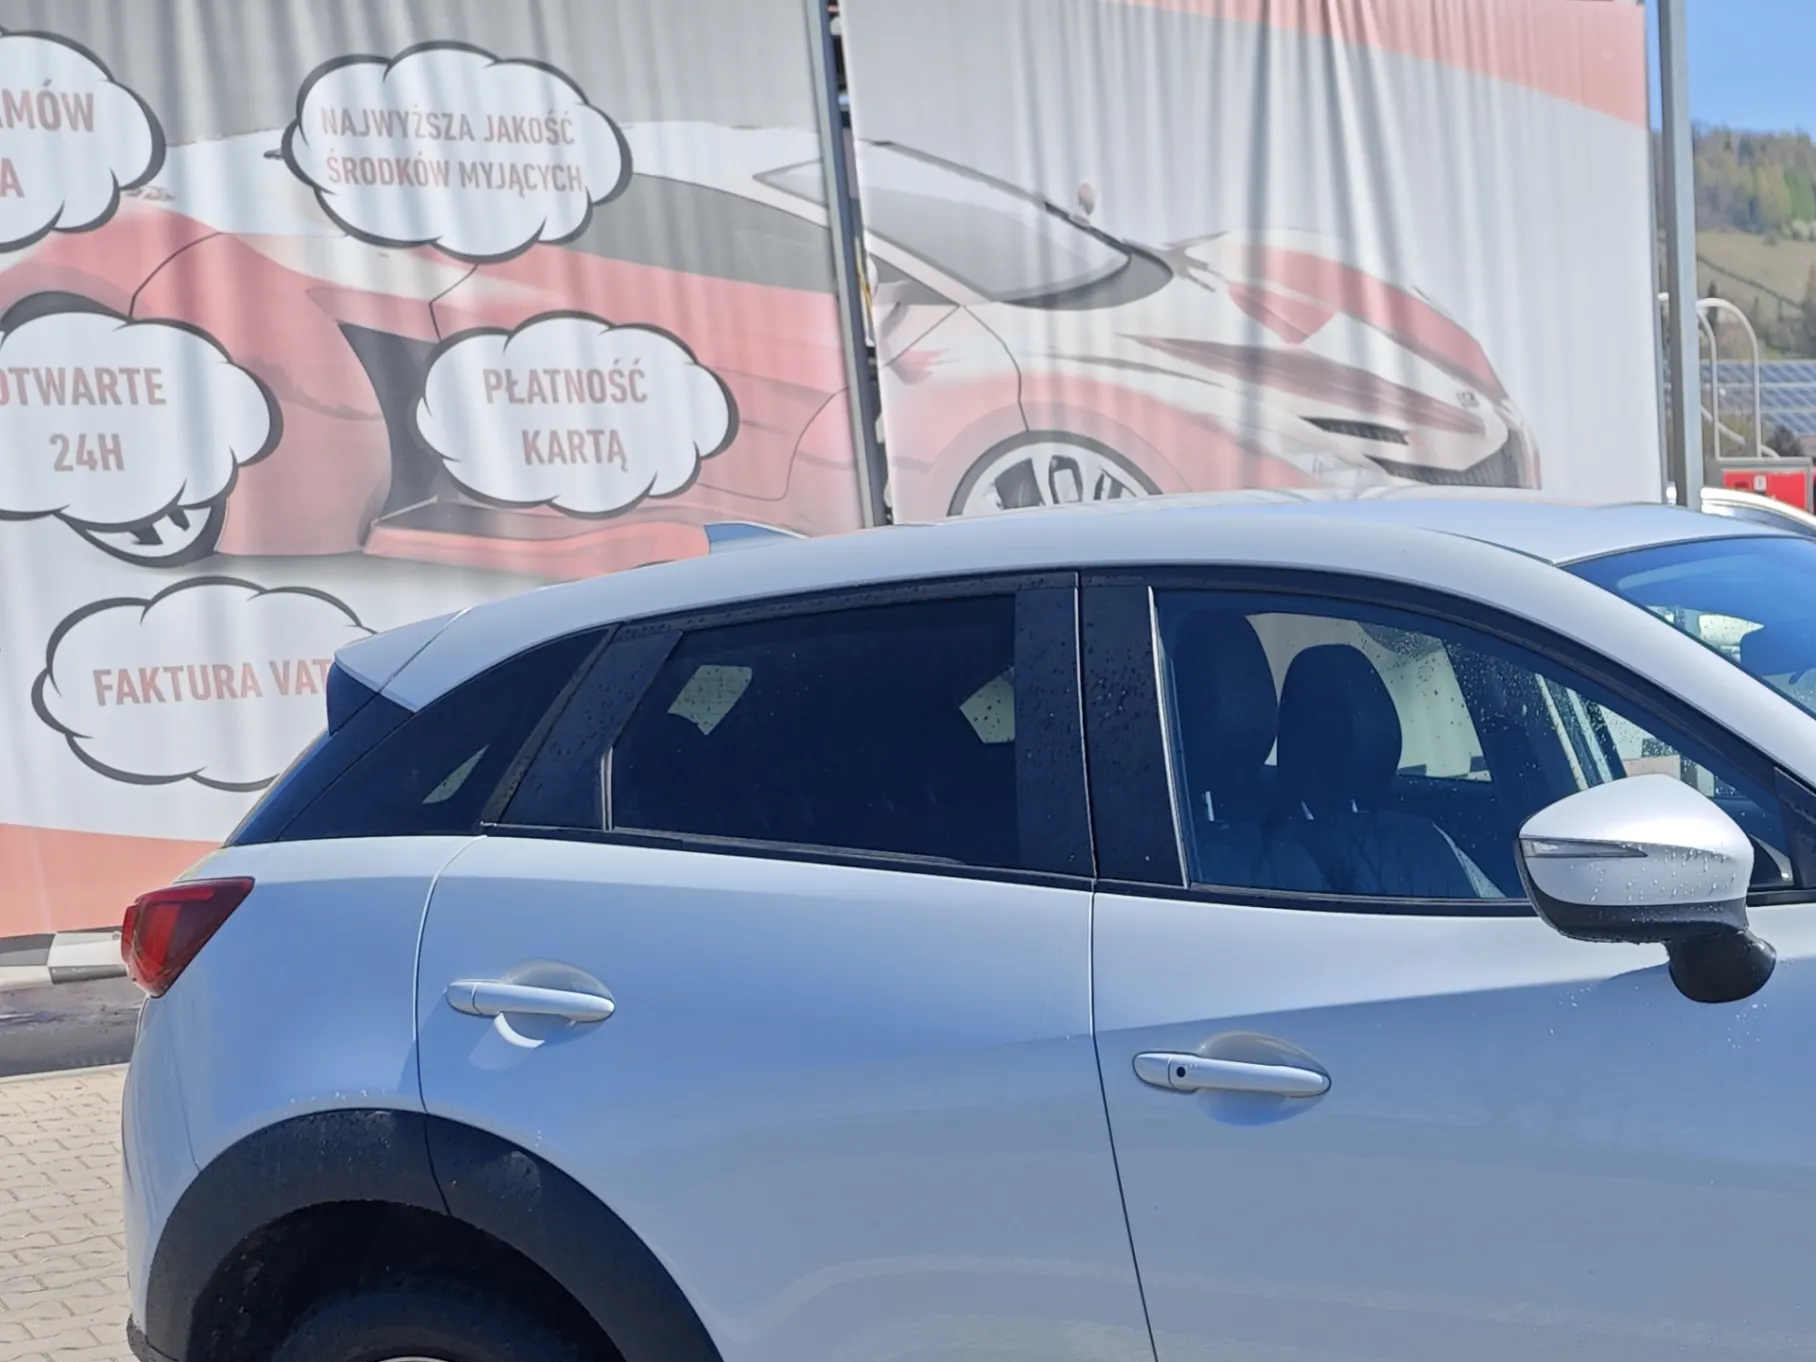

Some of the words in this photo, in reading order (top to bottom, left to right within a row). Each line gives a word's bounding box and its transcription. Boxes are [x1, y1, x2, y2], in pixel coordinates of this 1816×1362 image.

[0, 79, 94, 132] MÓW
[321, 104, 475, 142] NAJWYŻSZA
[484, 109, 576, 146] JAKOŚĆ
[326, 148, 450, 188] ŚRODKÓW
[458, 160, 584, 197] MYJĄCYCH
[483, 357, 648, 405] PŁATNOŚĆ
[50, 433, 125, 472] 24H
[521, 428, 629, 473] KARTĄ
[93, 662, 263, 707] FAKTURA
